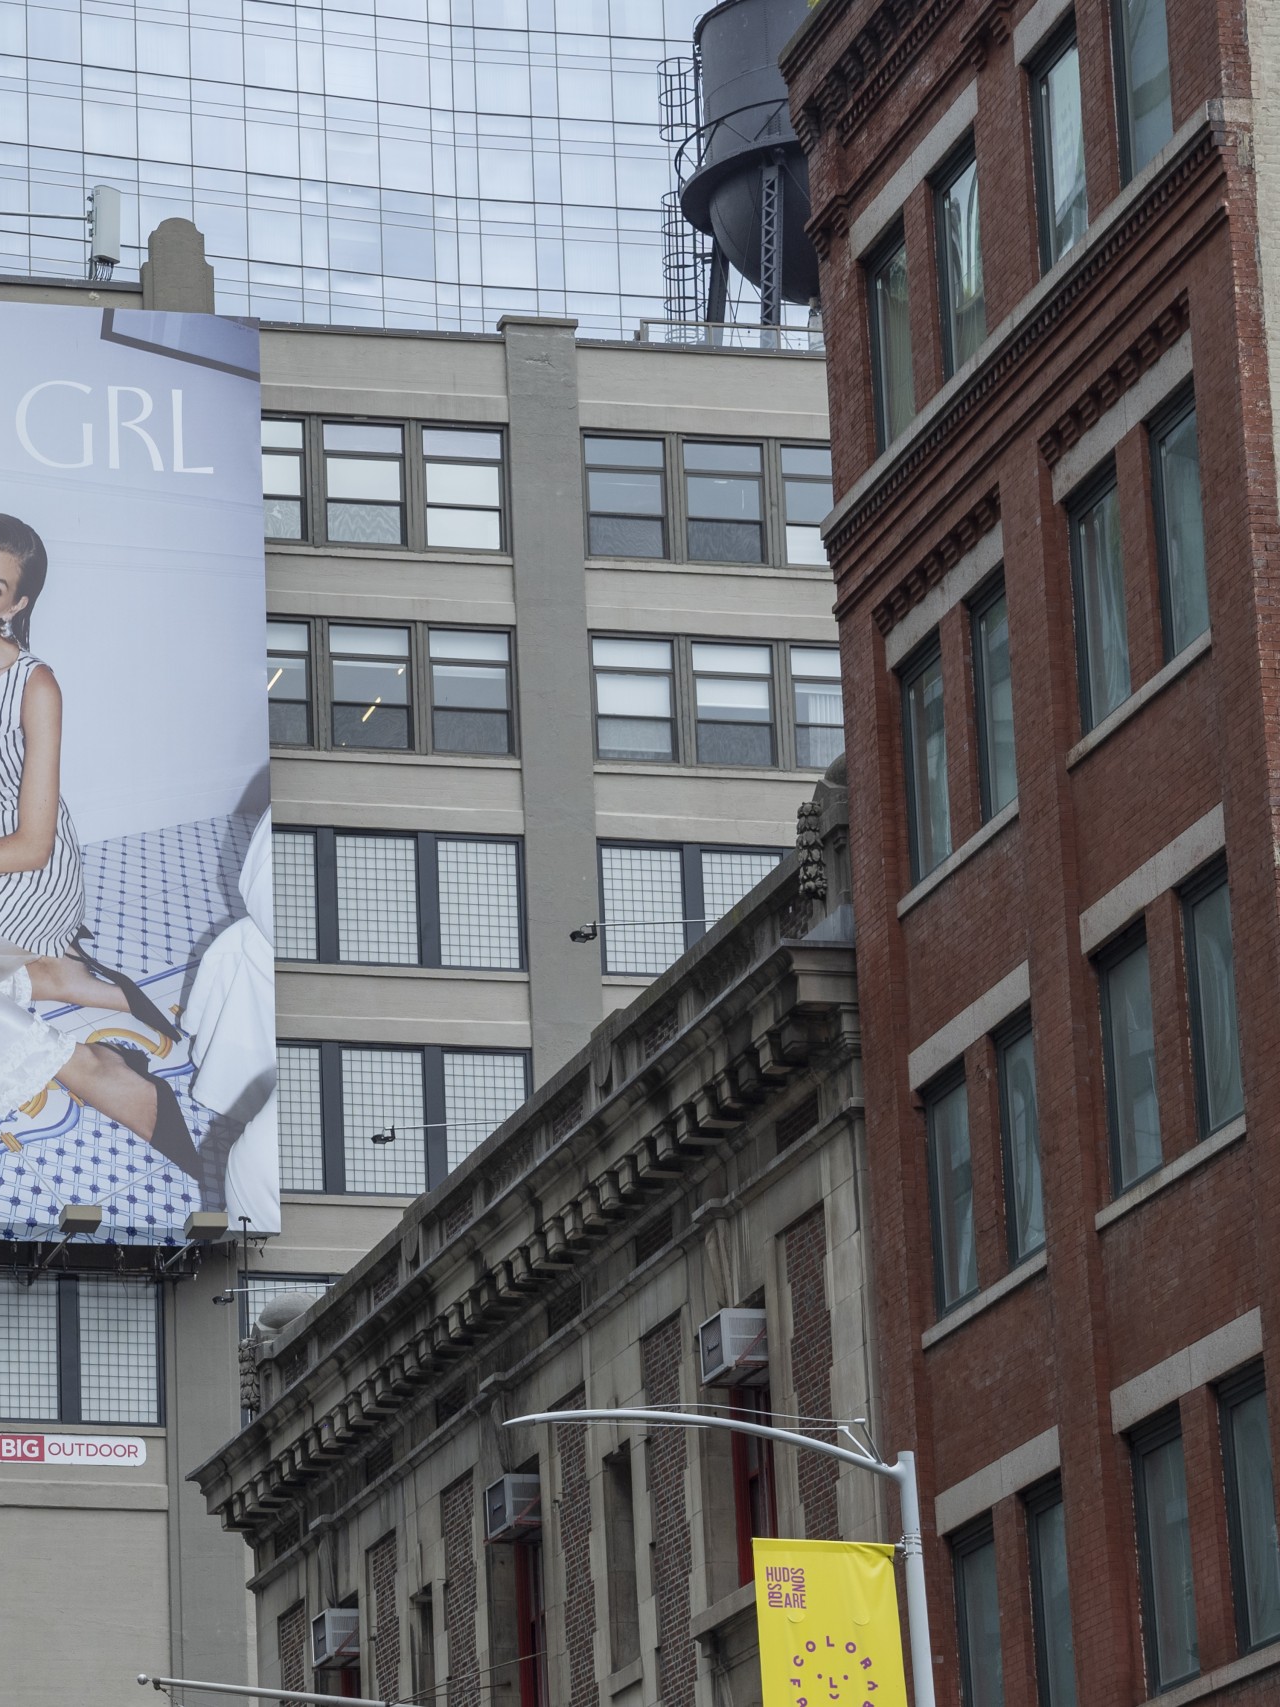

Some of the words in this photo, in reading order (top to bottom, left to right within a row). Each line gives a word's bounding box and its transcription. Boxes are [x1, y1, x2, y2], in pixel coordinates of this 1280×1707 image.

[15, 379, 214, 475] GRL
[1, 1438, 40, 1458] BIG
[48, 1442, 139, 1458] OUTDOOR
[793, 1635, 872, 1670] COLOR
